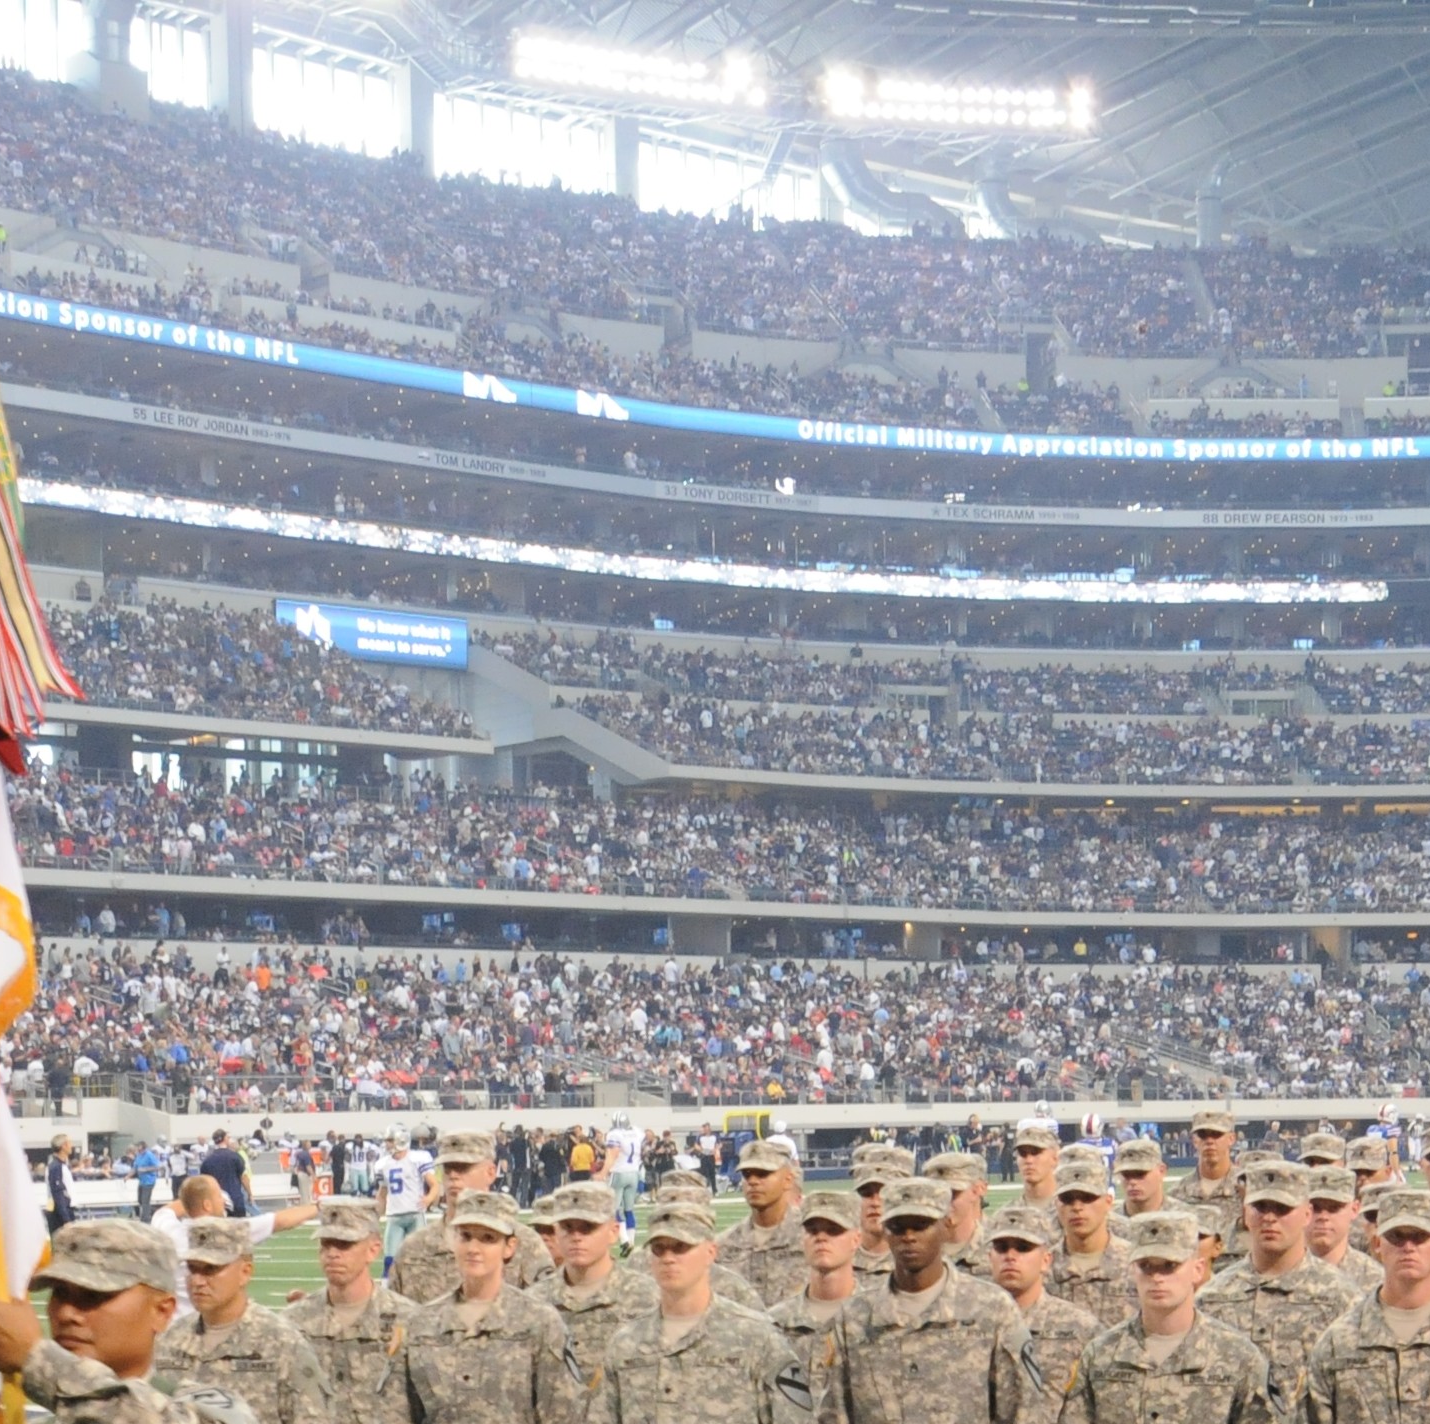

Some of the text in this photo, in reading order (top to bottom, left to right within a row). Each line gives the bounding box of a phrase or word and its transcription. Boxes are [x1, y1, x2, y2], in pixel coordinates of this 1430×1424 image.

[59, 302, 164, 341] Sponsor
[172, 323, 198, 347] of
[206, 329, 247, 356] the
[254, 337, 300, 365] NFL
[133, 408, 147, 421] 55
[153, 411, 174, 424] LEE
[177, 415, 200, 428] ROY
[203, 417, 249, 436] JORDAN
[798, 419, 1420, 461] Official Military Appreciation Sponsor of the NFL
[434, 453, 459, 468] TOM
[462, 457, 506, 476] LANDRY
[664, 485, 678, 497] 33
[683, 486, 713, 500] TONY
[718, 489, 771, 505] DORSETT
[946, 506, 969, 518] TEX
[973, 509, 1035, 521] SCHRAMM
[1203, 512, 1219, 524] 88
[1223, 512, 1262, 524] DREW
[1265, 512, 1326, 524] PEARSON
[377, 619, 409, 636] know
[411, 622, 440, 639] what
[398, 641, 410, 653] to
[624, 1141, 637, 1164] 1
[317, 1178, 331, 1197] G
[388, 1167, 403, 1195] 5
